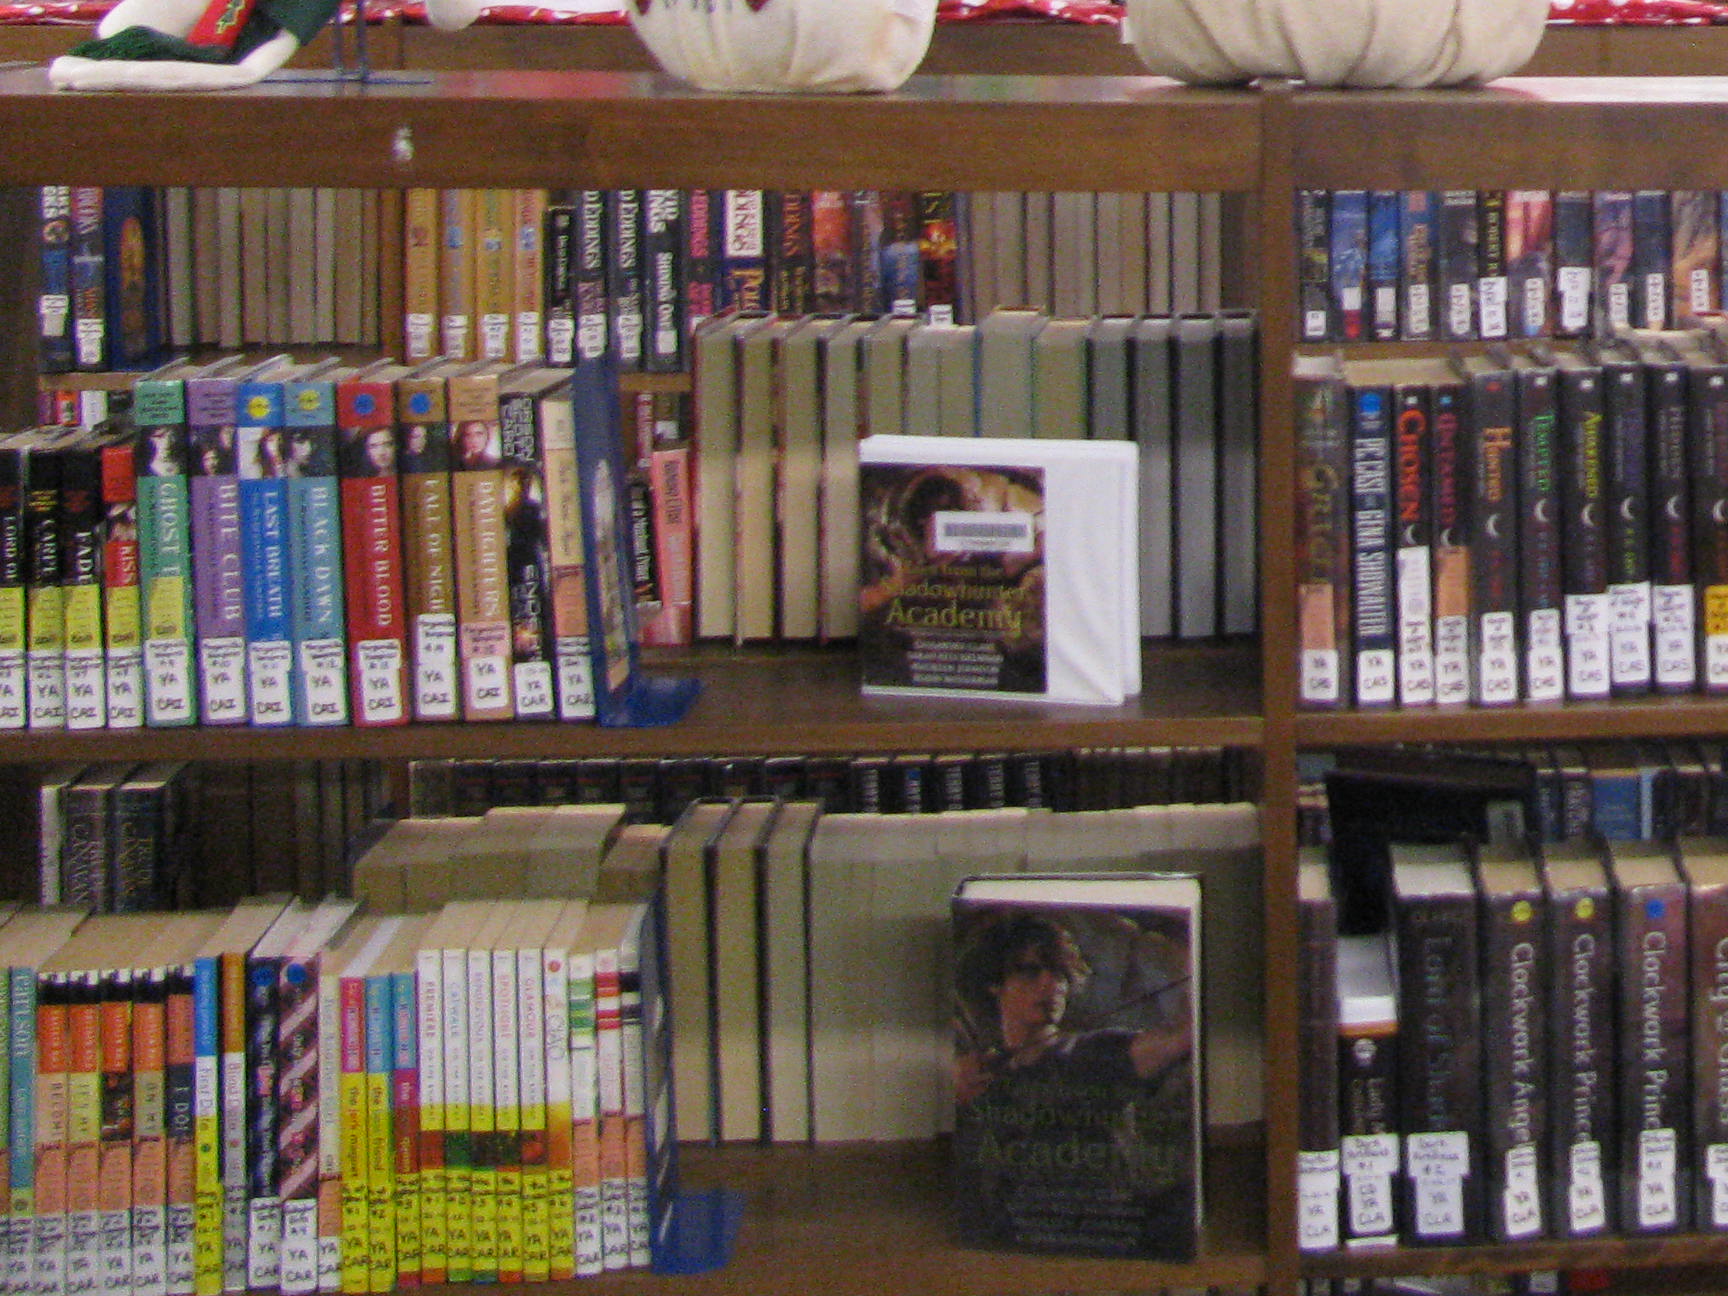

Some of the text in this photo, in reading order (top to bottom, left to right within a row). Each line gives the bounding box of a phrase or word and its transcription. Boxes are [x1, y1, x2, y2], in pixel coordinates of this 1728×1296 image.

[160, 482, 181, 553] GHOST
[1397, 408, 1427, 522] CHOSEN
[218, 483, 243, 621] BITE CLUB
[262, 491, 283, 619] LAST BREATH
[311, 485, 332, 624] BLACK DAWN
[370, 484, 392, 627] BITTER BLOOD
[423, 479, 444, 614] FALL OF NIGH
[1354, 510, 1388, 637] GINA SHOWALTER
[885, 597, 1024, 639] Academy
[1510, 941, 1536, 1075] Clockwork
[1572, 932, 1597, 1066] Clockwork
[1641, 930, 1668, 1062] Clockwork
